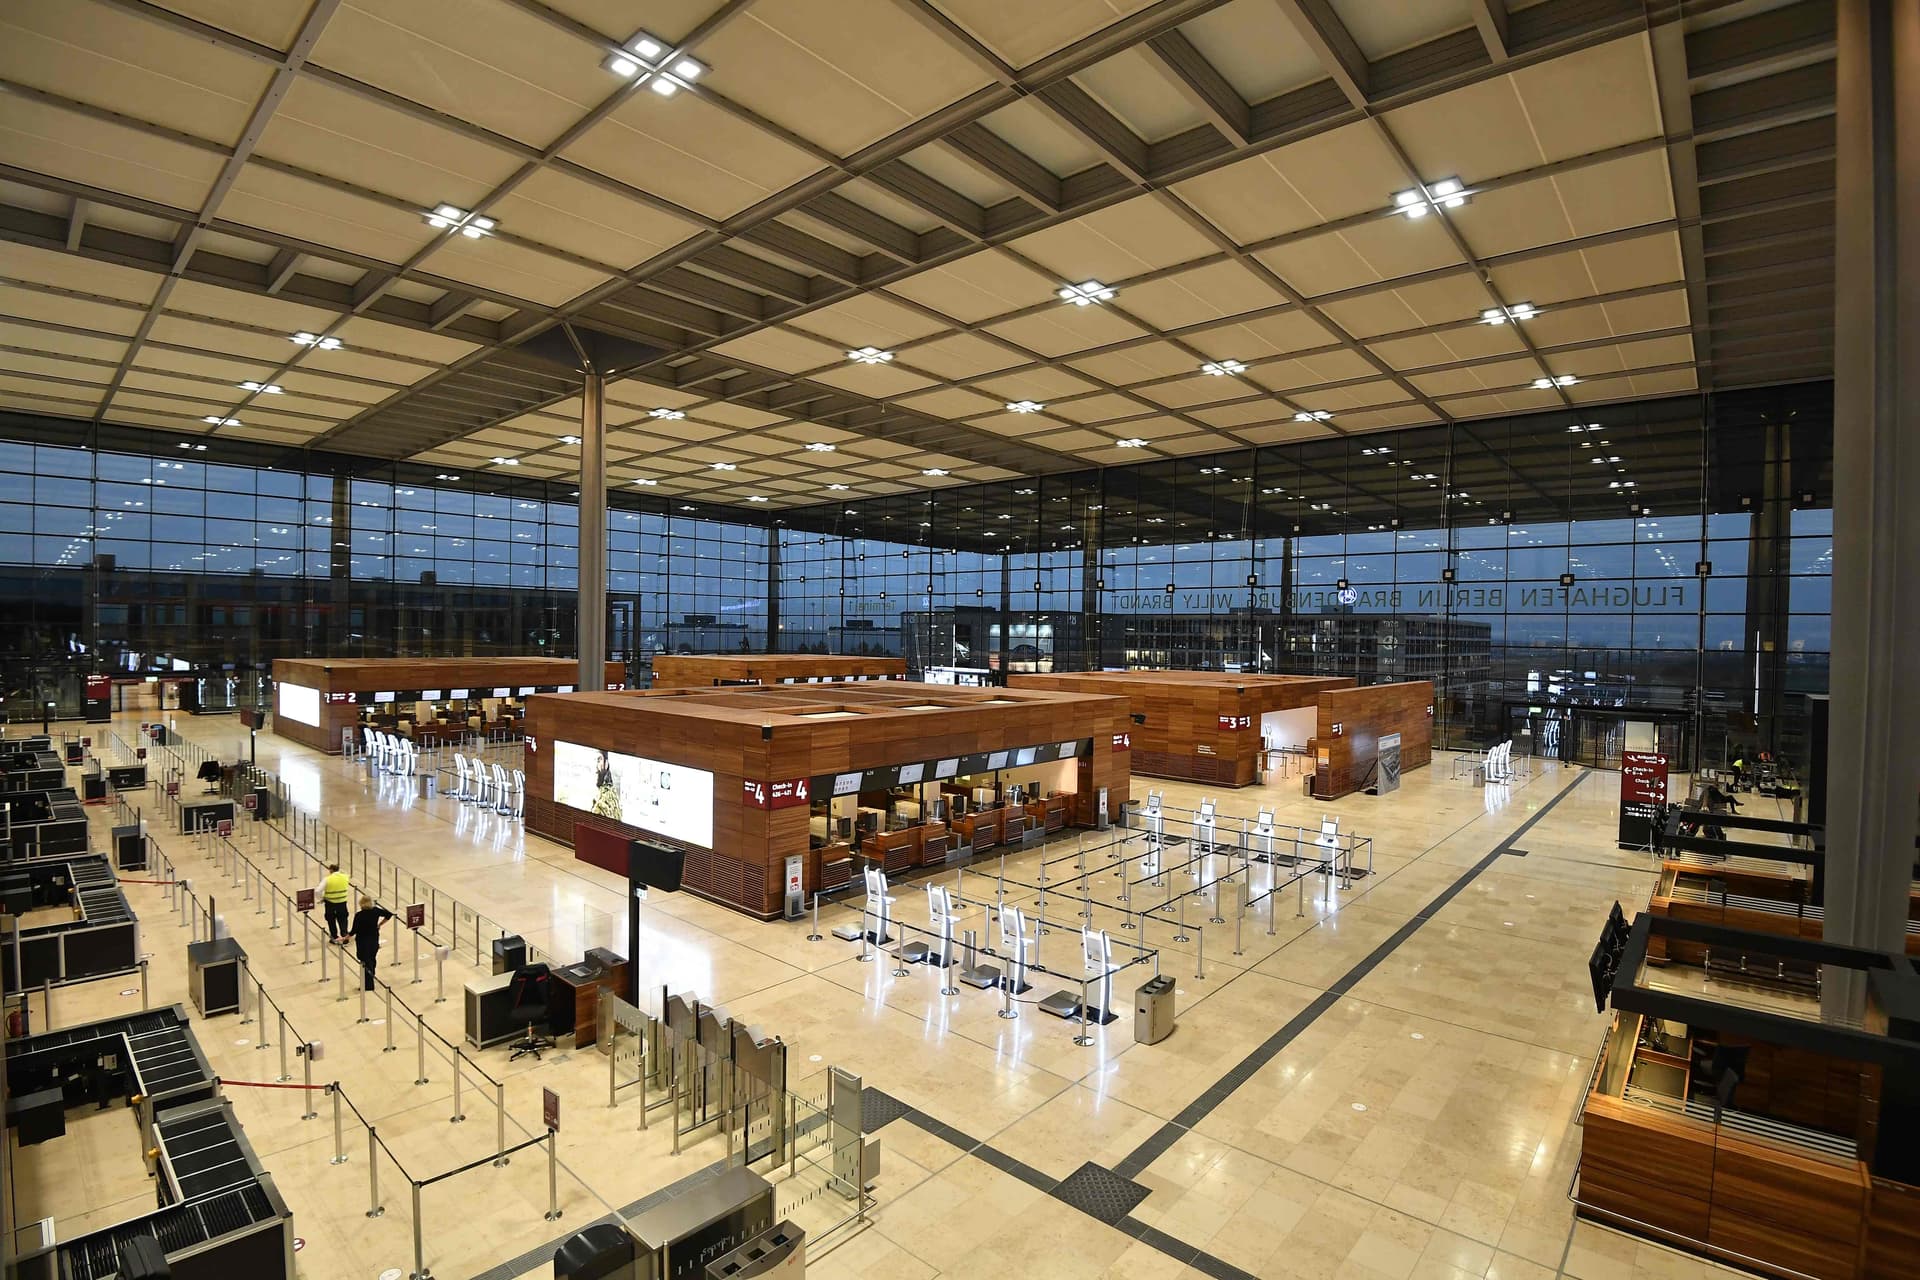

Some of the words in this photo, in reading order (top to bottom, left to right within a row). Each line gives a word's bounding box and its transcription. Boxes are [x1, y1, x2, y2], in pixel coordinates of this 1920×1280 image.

[348, 692, 357, 703] 2
[1229, 716, 1237, 729] 3
[1123, 733, 1130, 748] 4
[772, 782, 793, 791] Check-in
[796, 780, 808, 800] 4
[755, 784, 765, 804] 4
